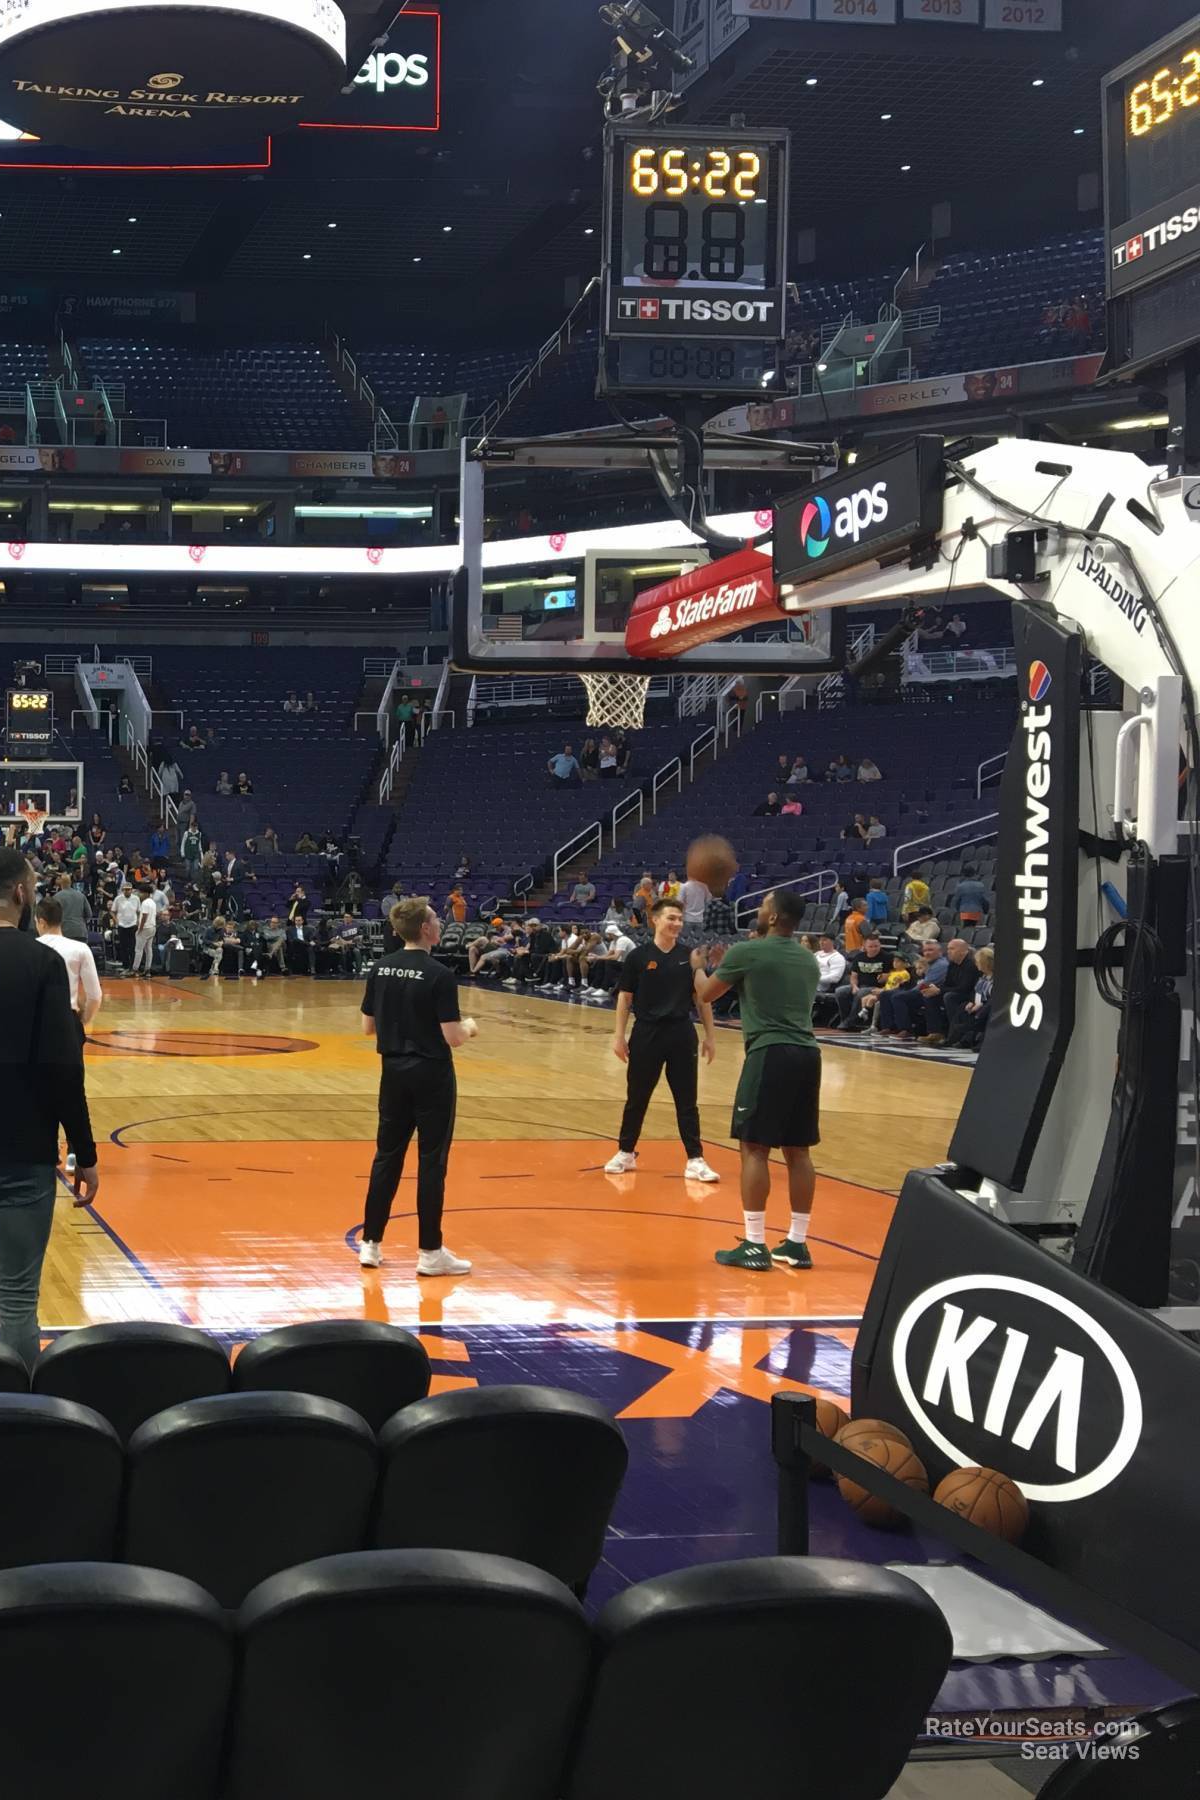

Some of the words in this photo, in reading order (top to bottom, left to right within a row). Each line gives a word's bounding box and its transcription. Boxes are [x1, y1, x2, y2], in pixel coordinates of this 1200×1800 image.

[833, 1, 879, 17] 2014
[920, 0, 964, 16] 2013
[1002, 7, 1045, 25] 2012
[353, 49, 429, 92] aps
[12, 80, 120, 99] TALKING
[127, 89, 200, 104] STICK
[204, 92, 305, 105] RESORT
[104, 104, 192, 119] ARENA
[631, 148, 761, 197] 65:22
[1143, 206, 1200, 251] TISS
[86, 296, 157, 309] HAWTHORNE
[662, 299, 775, 322] TISSOT
[874, 385, 951, 406] BARKLEY
[1000, 375, 1013, 389] 34
[145, 457, 187, 468] DAVIS
[295, 460, 368, 472] CHAMBERS
[400, 459, 411, 473] 24
[834, 480, 889, 543] aps
[1075, 544, 1147, 638] SPALDING
[12, 694, 48, 708] 65:22
[1008, 702, 1053, 1032] Southwest
[377, 966, 425, 981] zerorez
[922, 1302, 1085, 1474] KIA
